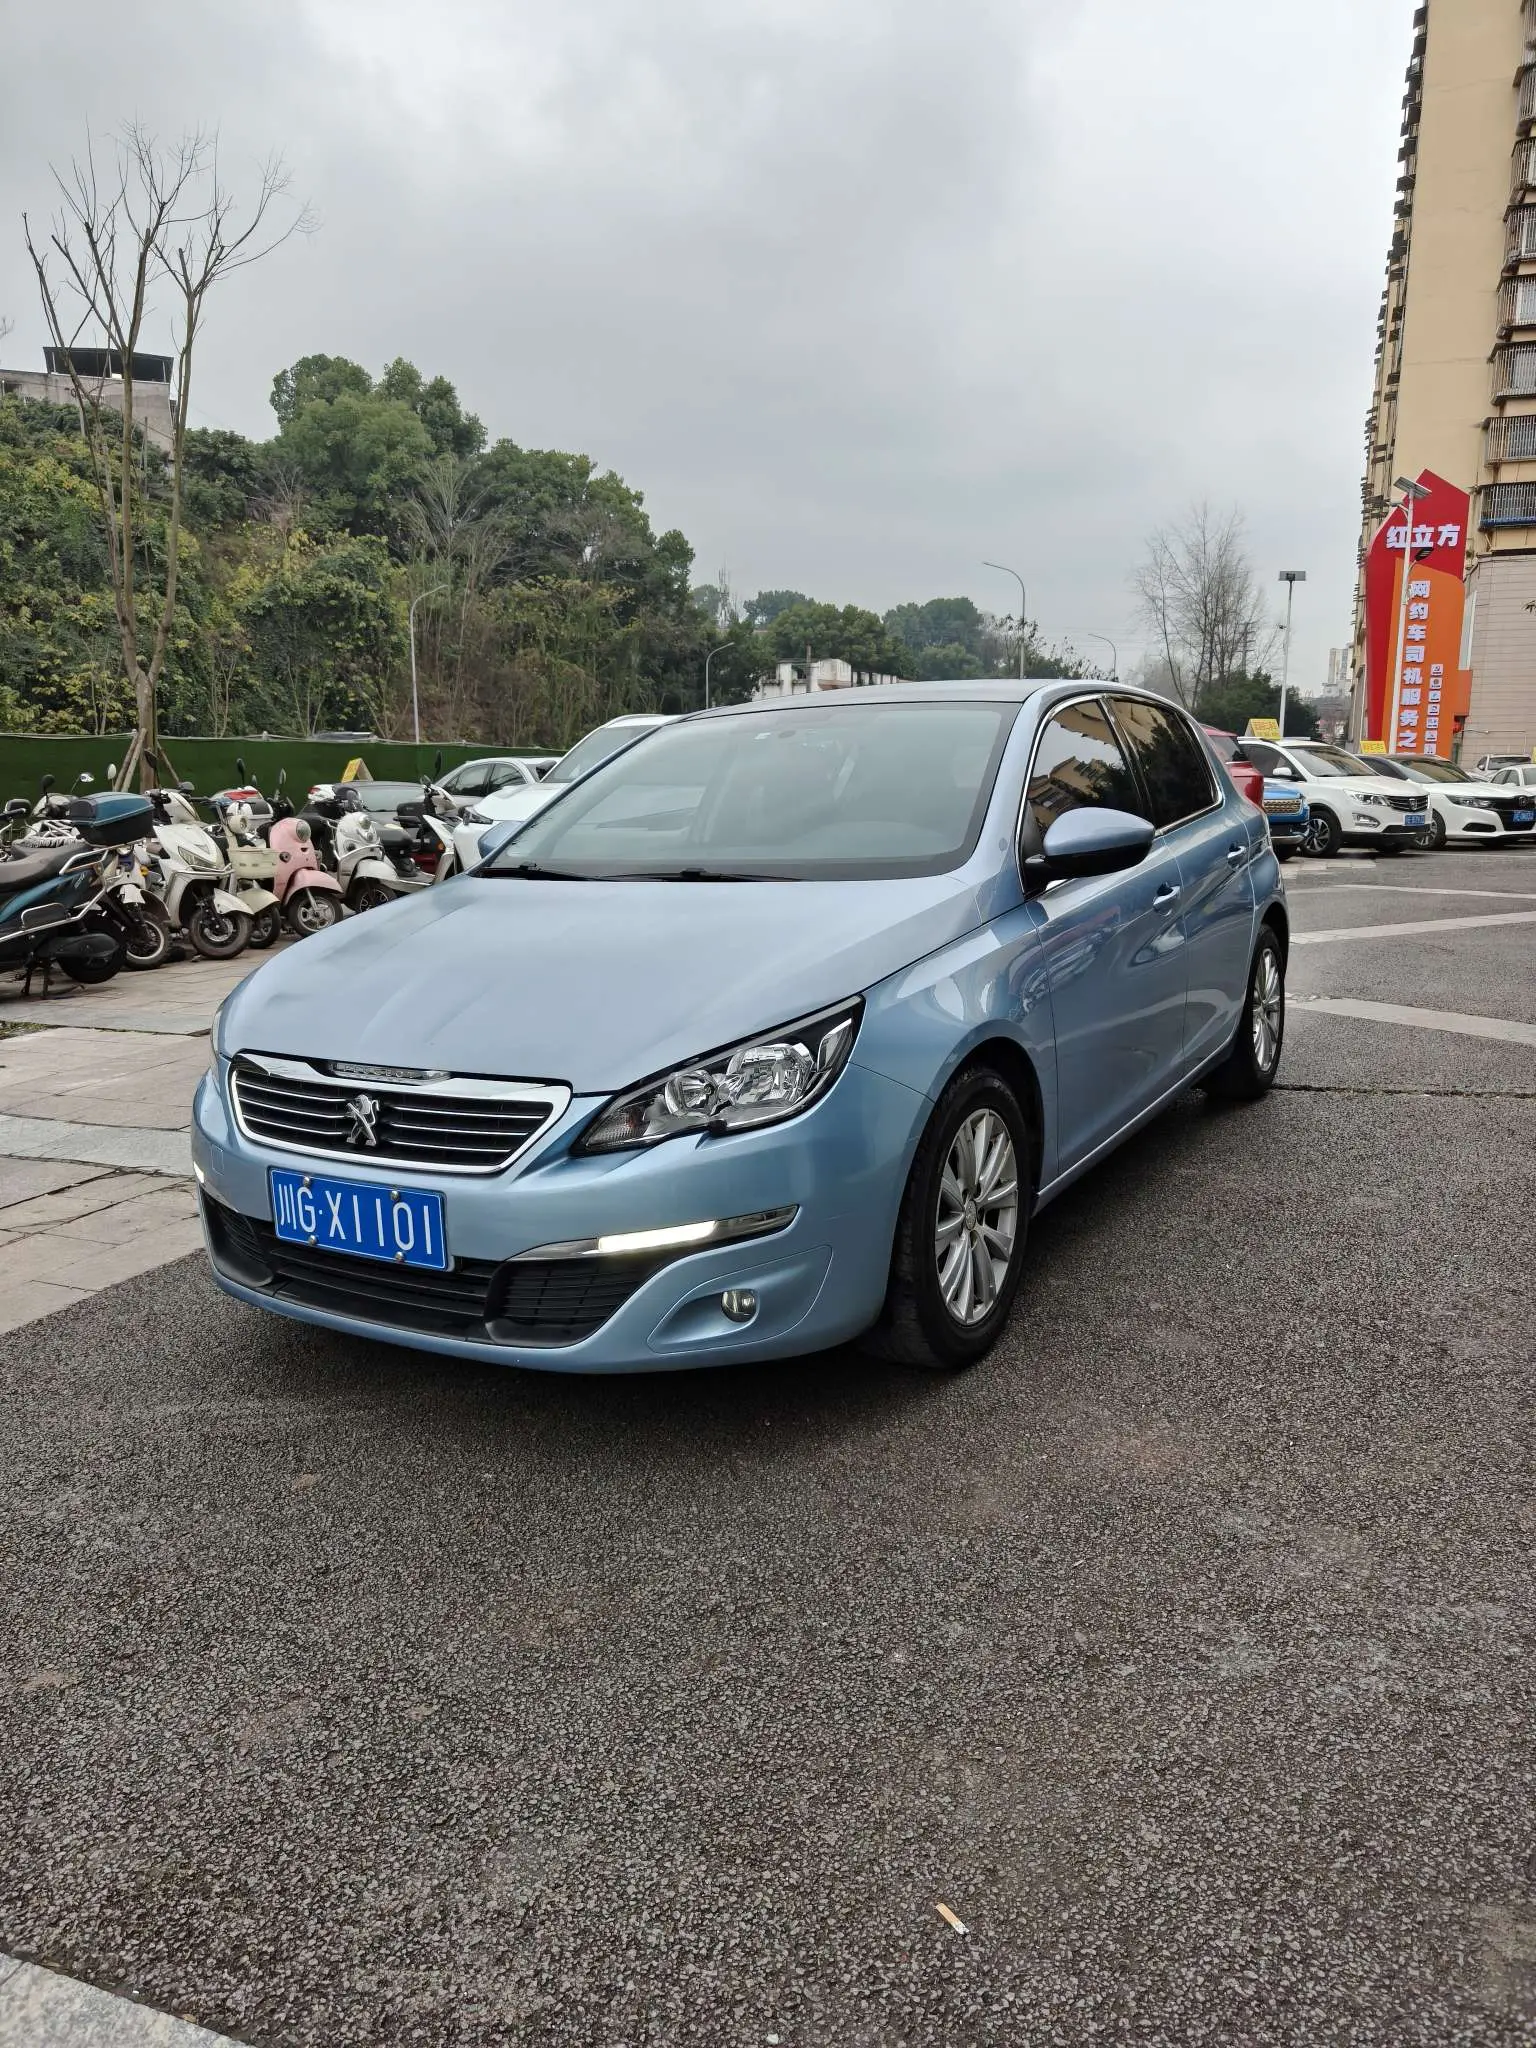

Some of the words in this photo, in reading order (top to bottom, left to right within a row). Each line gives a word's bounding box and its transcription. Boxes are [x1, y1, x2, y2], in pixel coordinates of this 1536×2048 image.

[1386, 524, 1461, 549] 红立方
[1397, 580, 1431, 754] 网约车司机服务之
